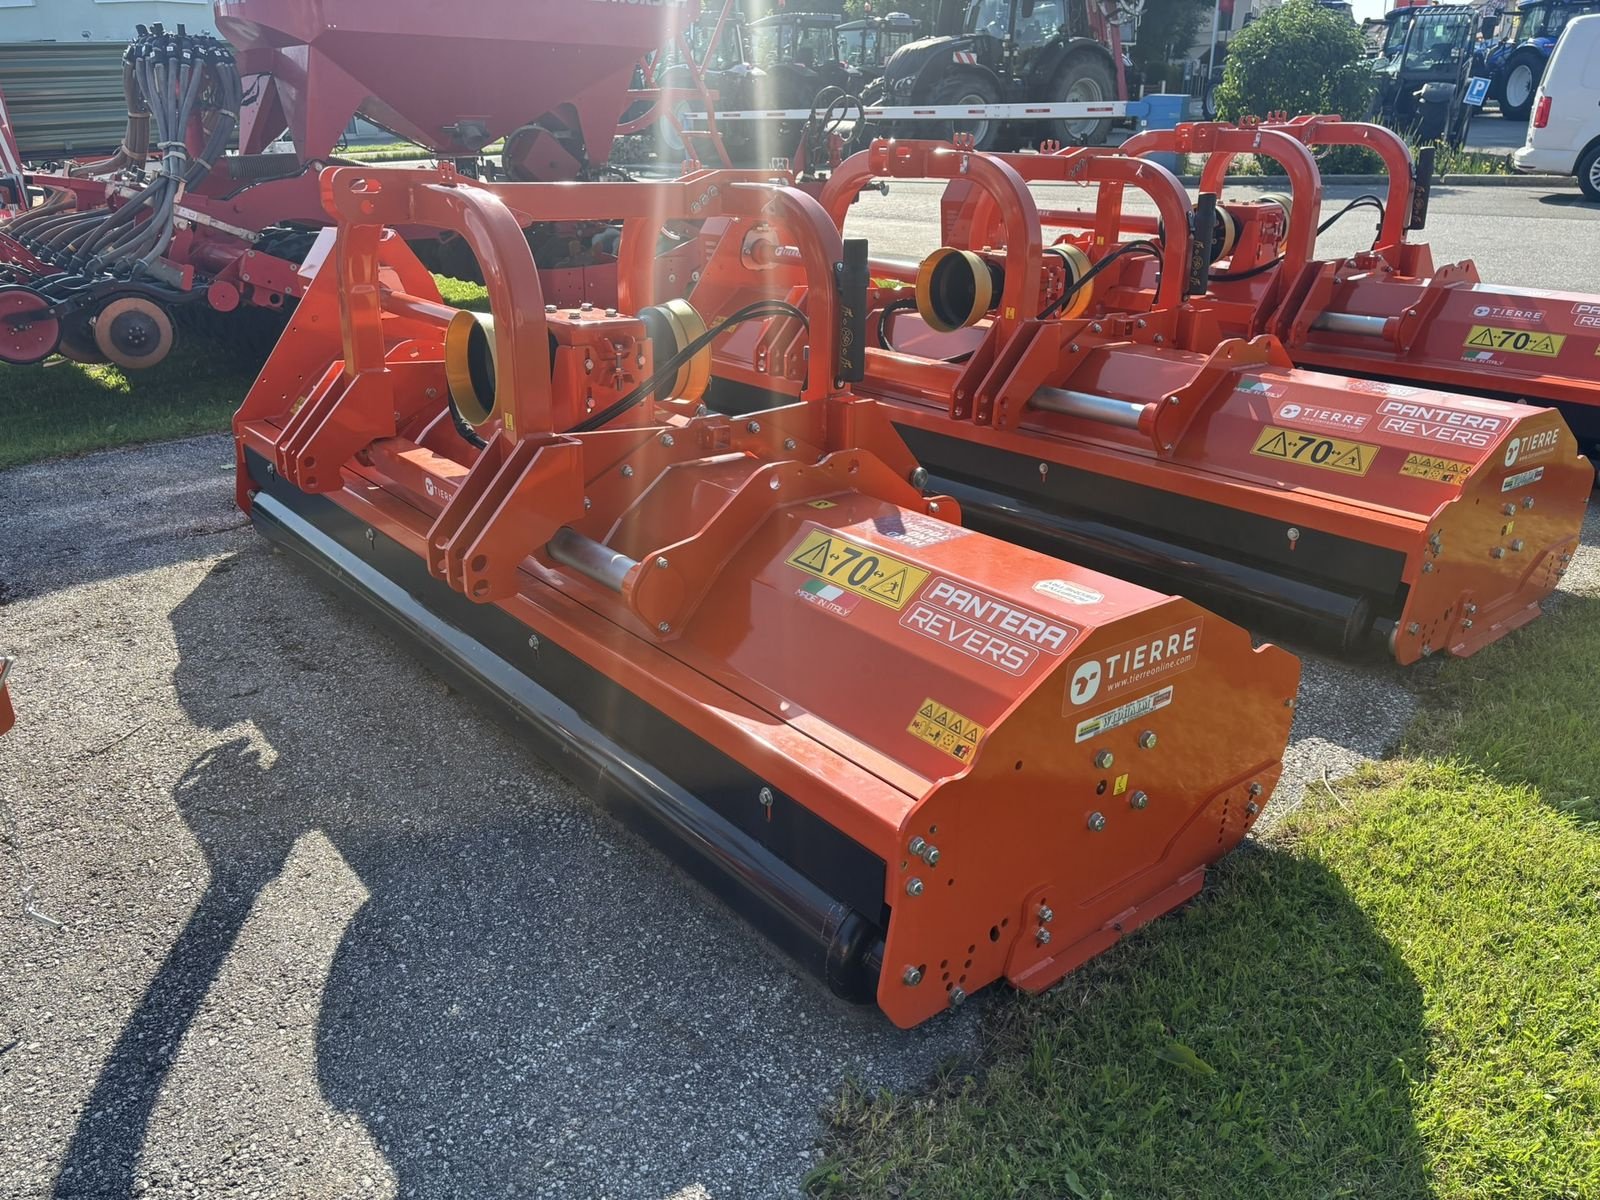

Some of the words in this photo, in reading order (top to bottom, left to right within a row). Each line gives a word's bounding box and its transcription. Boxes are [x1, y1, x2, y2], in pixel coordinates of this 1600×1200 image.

[1472, 80, 1485, 95] P
[1492, 307, 1543, 319] TIERRE
[1498, 331, 1530, 350] 70
[1303, 407, 1366, 426] TIERRE
[1383, 402, 1500, 431] PANTERA
[1384, 418, 1490, 446] REVERS
[1521, 428, 1559, 453] TIERRE
[1292, 436, 1333, 463] 70
[827, 546, 879, 587] 70
[795, 589, 817, 602] MADE
[817, 598, 827, 607] IN
[826, 603, 850, 617] ITALY
[928, 582, 1067, 649] PANTERA
[907, 606, 1029, 670] REVERS
[1106, 627, 1196, 679] TIERRE
[1107, 654, 1191, 692] www.tierreonline.com
